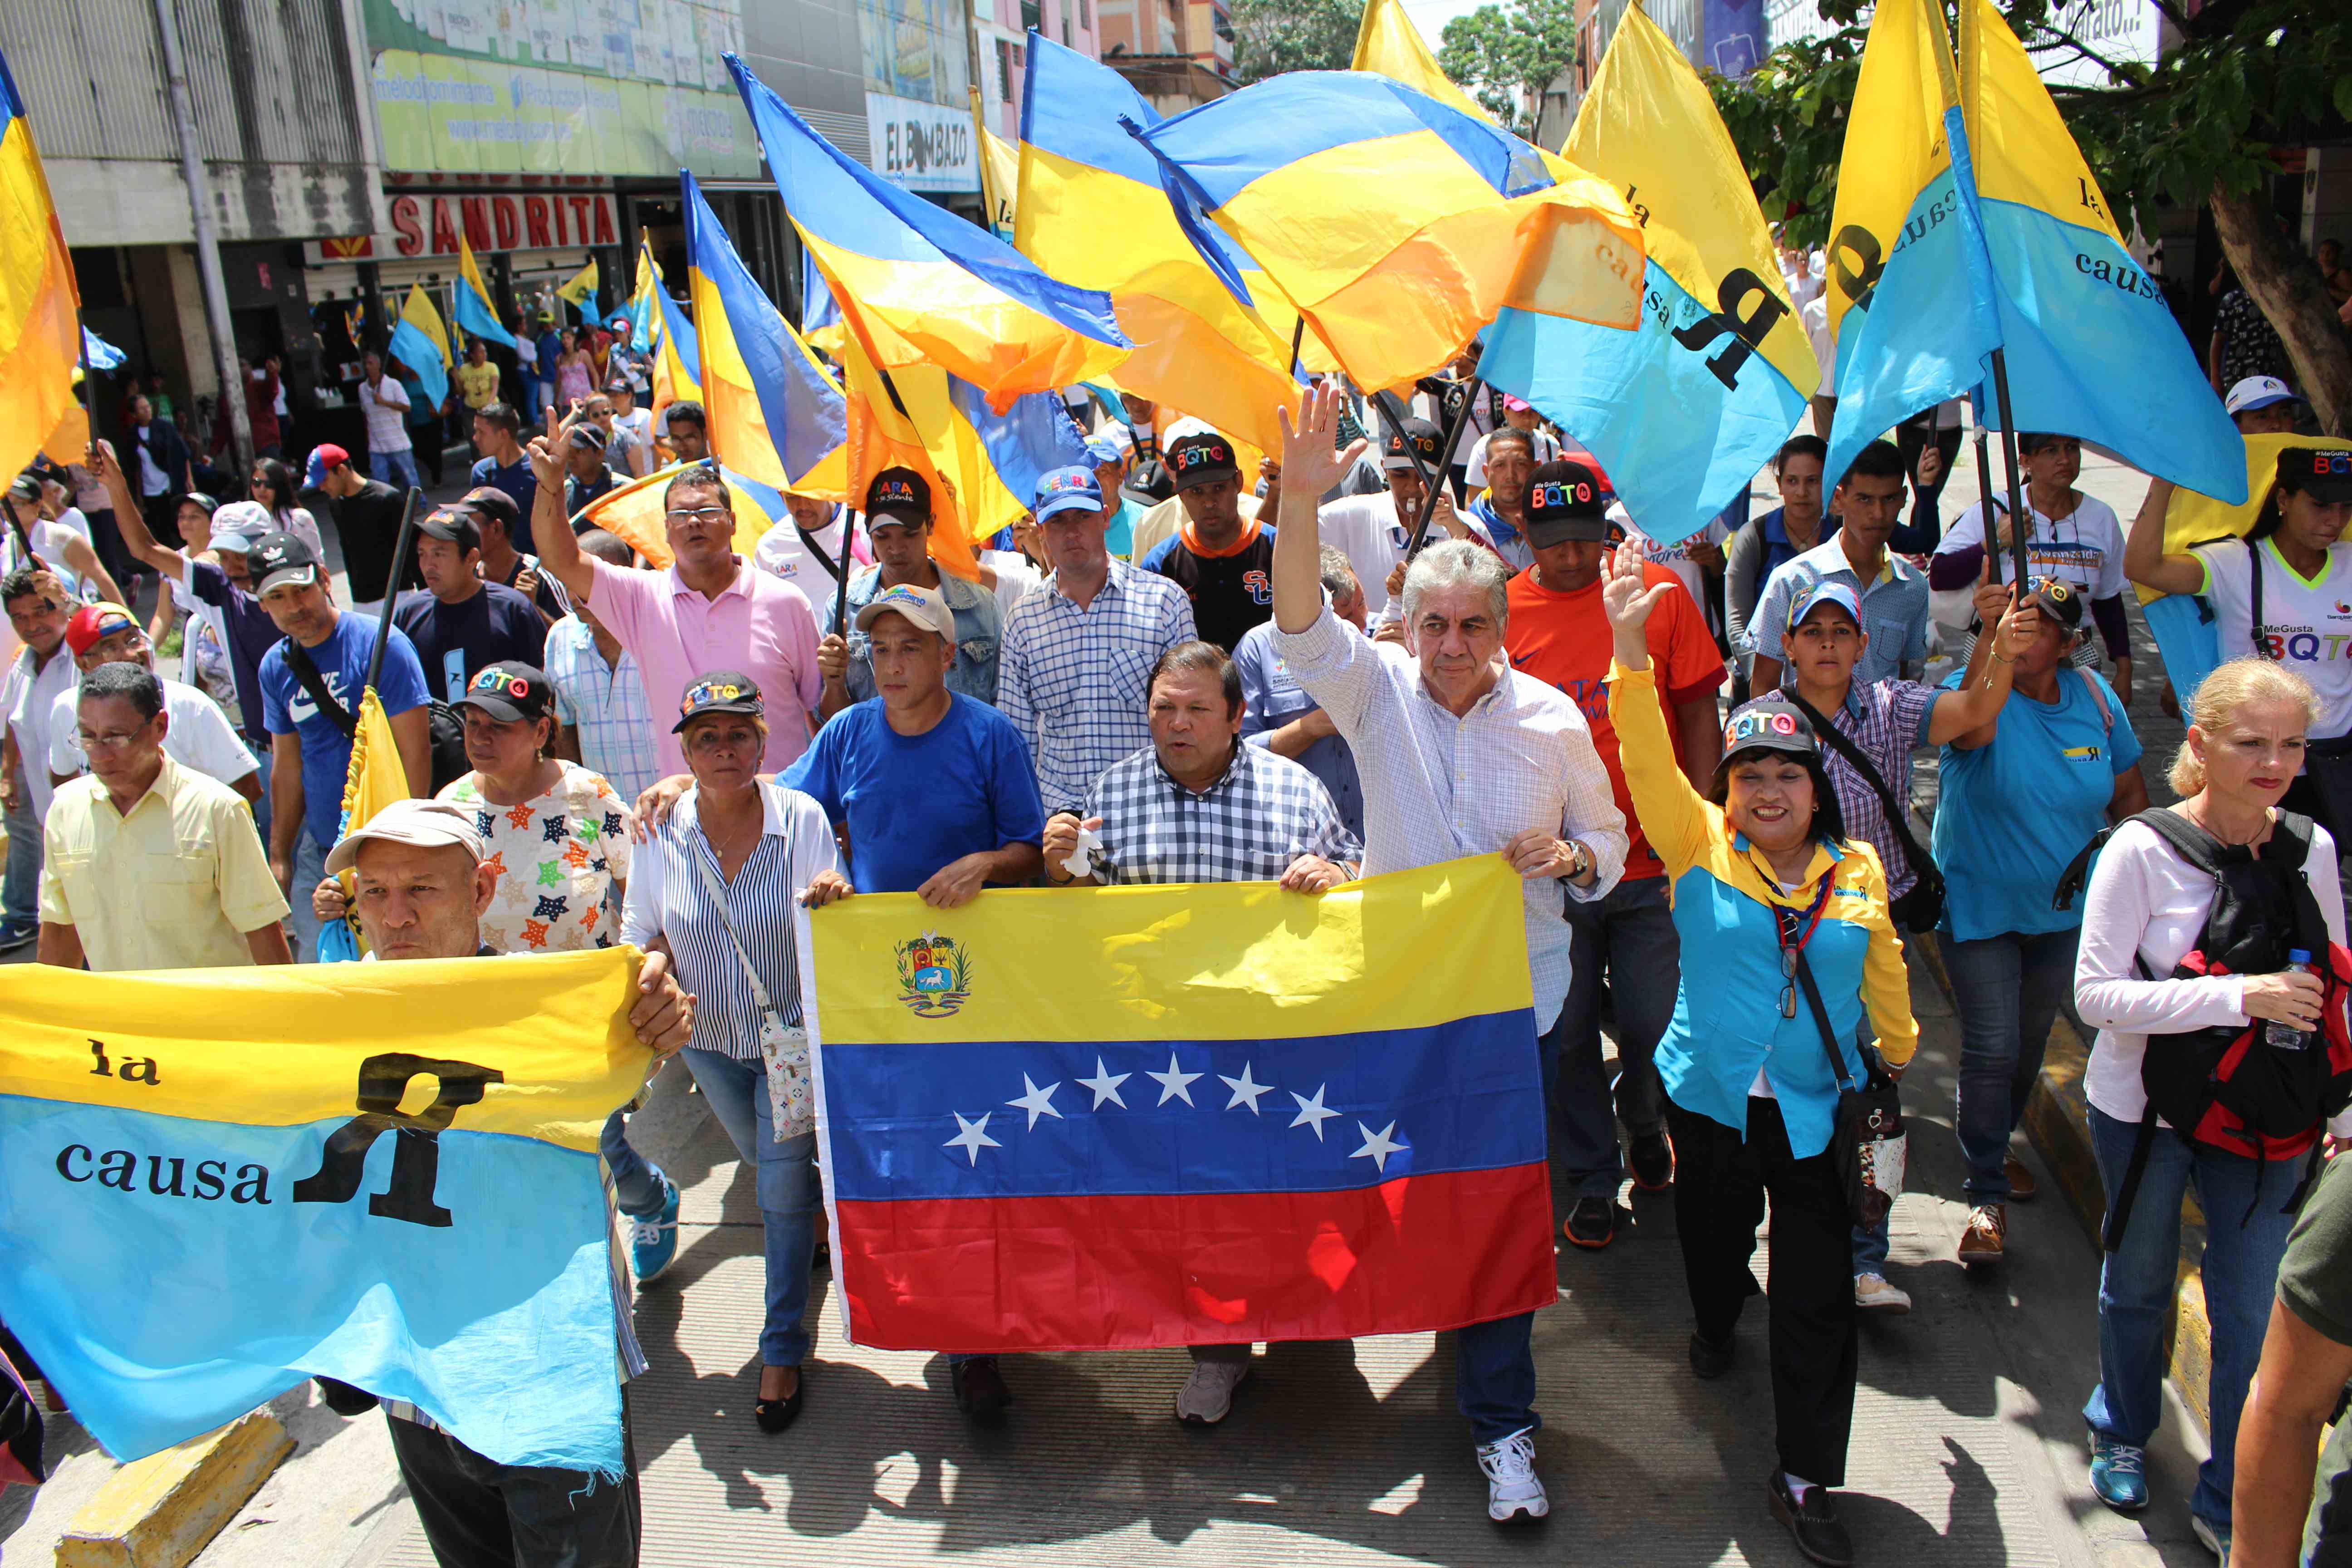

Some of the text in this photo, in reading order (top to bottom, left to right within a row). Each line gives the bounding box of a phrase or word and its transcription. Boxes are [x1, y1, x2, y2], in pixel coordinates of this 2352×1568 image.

[886, 122, 902, 171] EL
[1626, 183, 1650, 229] la
[2078, 176, 2104, 220] la
[392, 195, 615, 255] SANDRITA
[1177, 446, 1223, 470] BQTO
[1392, 435, 1434, 451] BTO
[887, 492, 914, 502] siente
[1044, 475, 1087, 494] HENRI
[1532, 482, 1592, 509] BQTO
[775, 563, 798, 574] LARA
[1725, 712, 1797, 750] BQTO
[86, 1037, 162, 1086] la
[55, 1142, 273, 1205] causa
